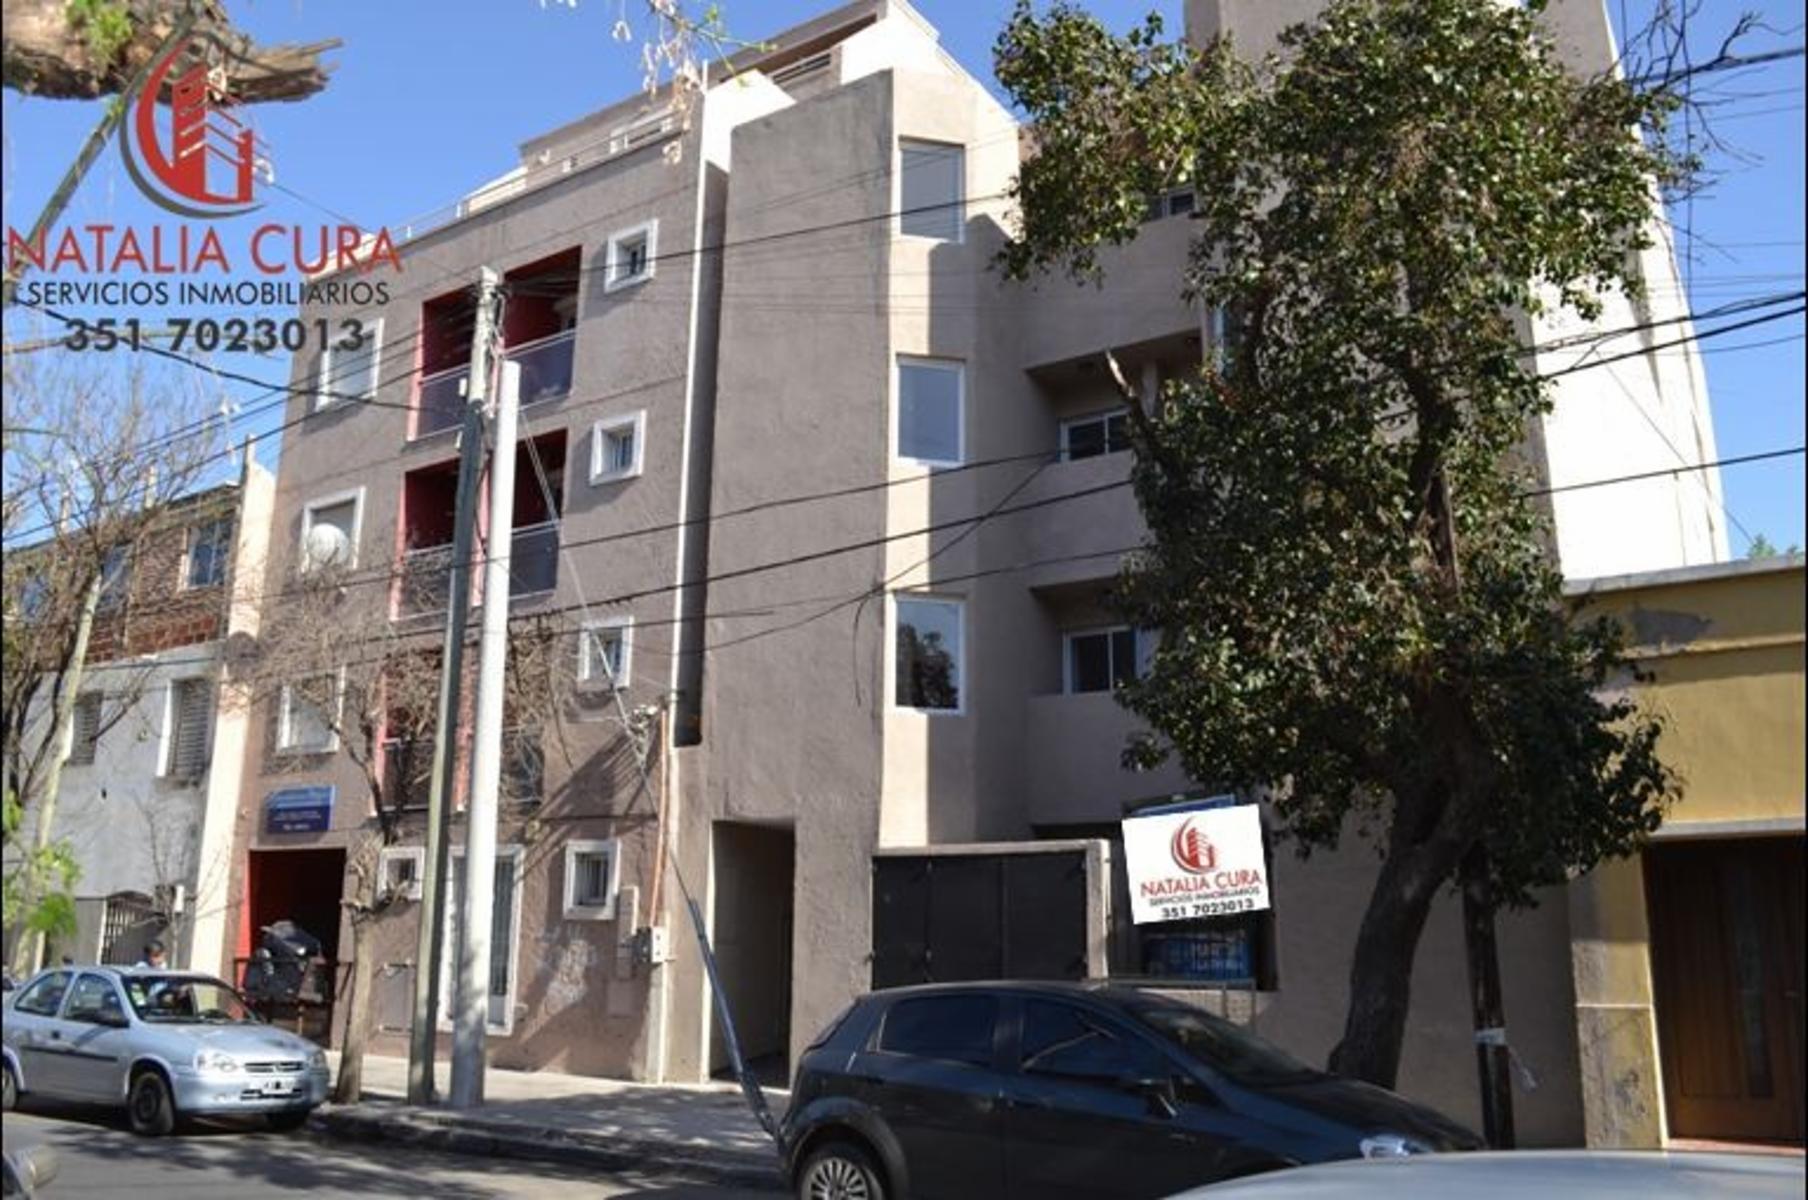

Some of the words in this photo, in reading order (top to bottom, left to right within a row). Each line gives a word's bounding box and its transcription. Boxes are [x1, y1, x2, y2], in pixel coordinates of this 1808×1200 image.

[1140, 876, 1210, 897] NATALIA
[1214, 870, 1262, 889] CURA
[1161, 906, 1186, 918] 351
